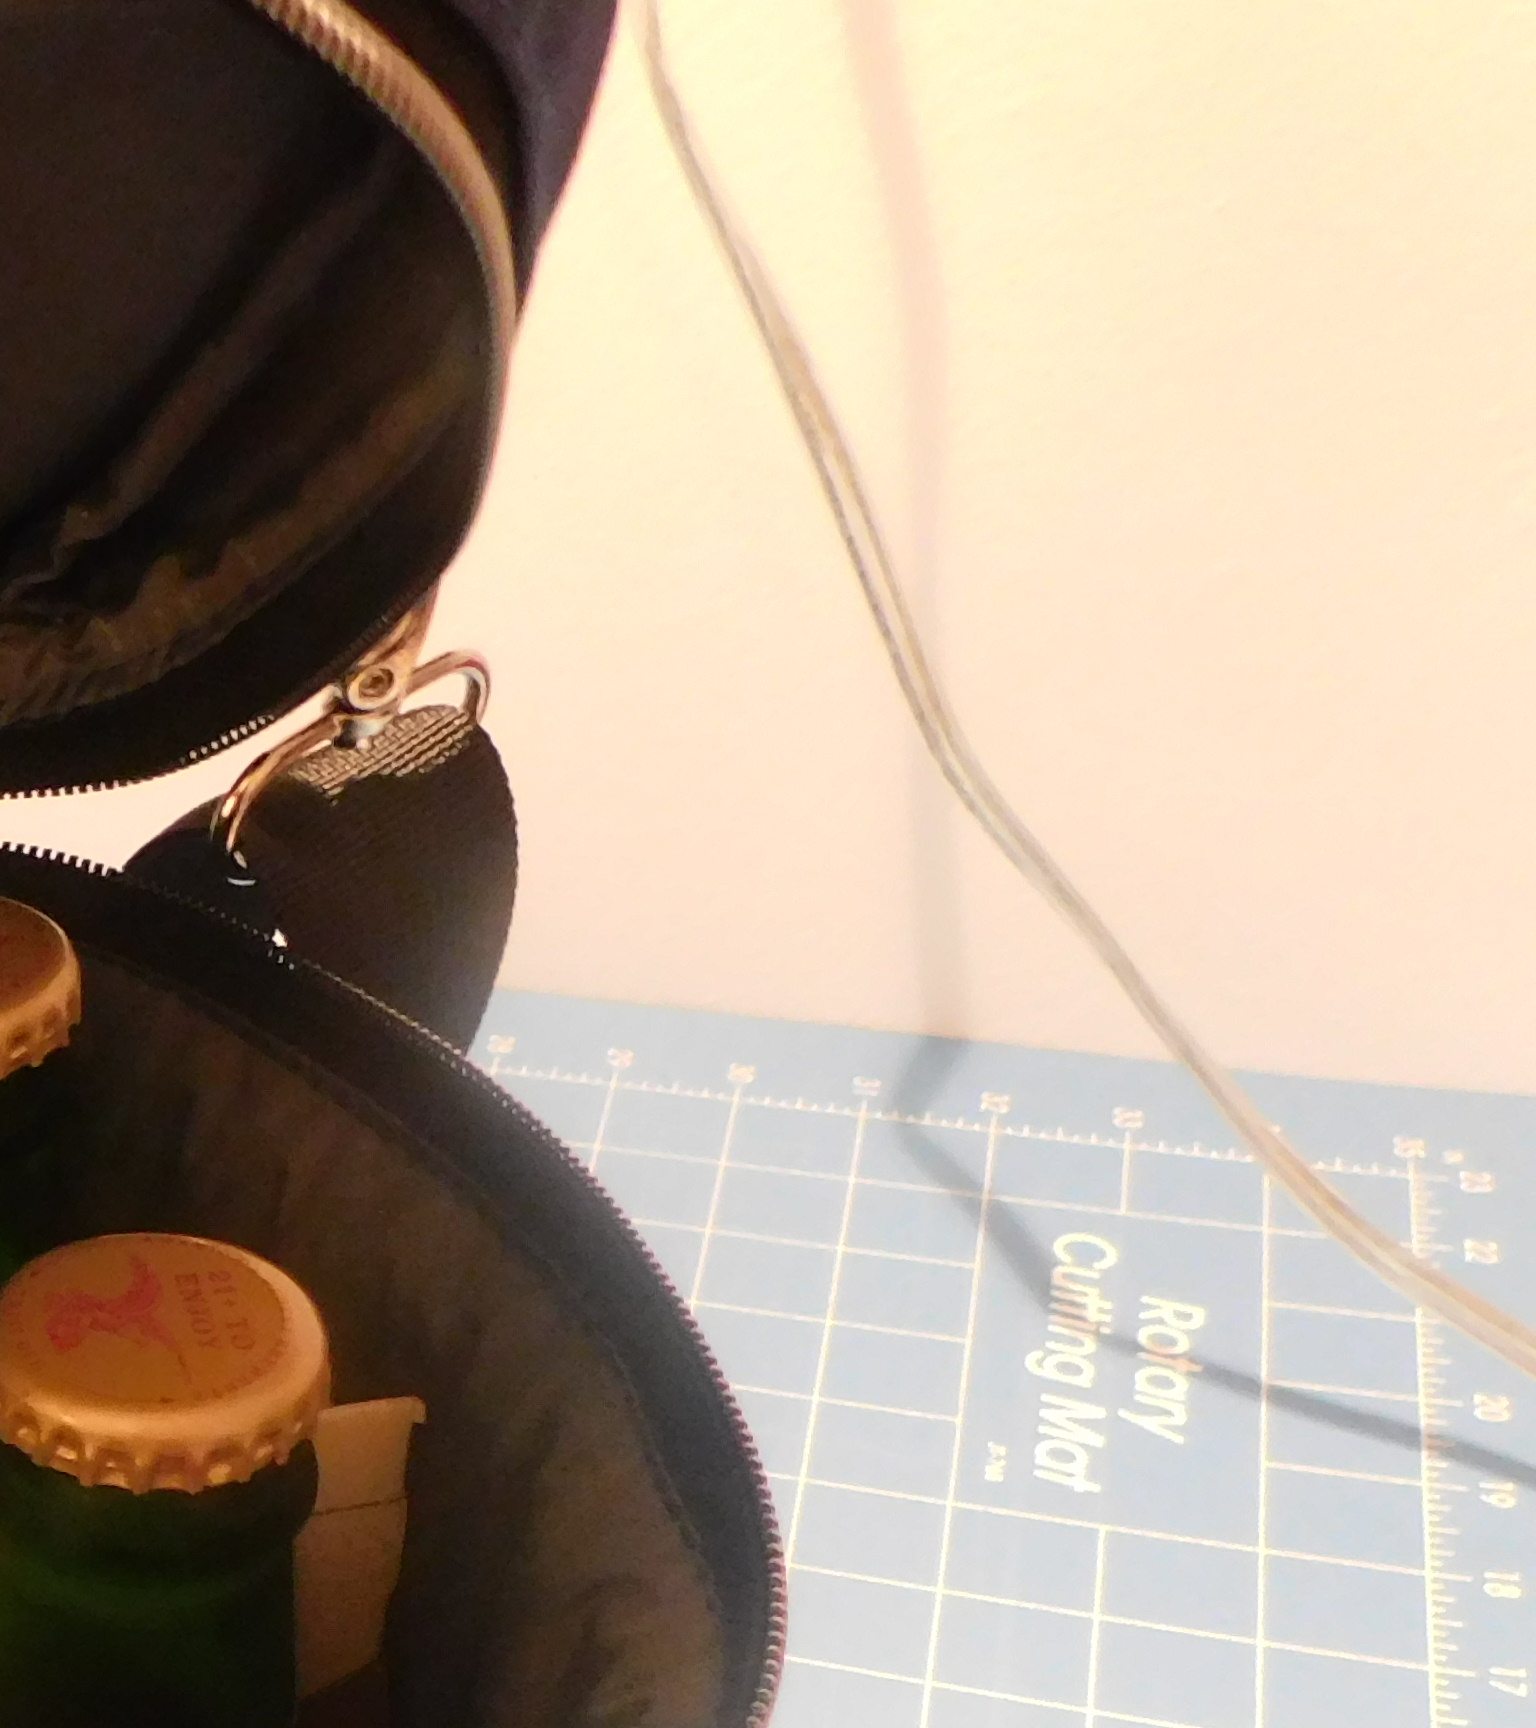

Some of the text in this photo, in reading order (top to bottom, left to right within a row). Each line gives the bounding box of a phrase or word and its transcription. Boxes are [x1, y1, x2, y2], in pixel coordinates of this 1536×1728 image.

[1464, 1238, 1500, 1265] 22
[173, 1270, 222, 1351] ENJOY
[225, 1314, 256, 1352] TO
[1025, 1232, 1118, 1494] Cutting Mat
[1118, 1294, 1206, 1445] Rotary
[1473, 1393, 1512, 1422] 20
[1479, 1481, 1518, 1510] 19
[1482, 1570, 1522, 1600] 18
[1488, 1666, 1528, 1698] 17
